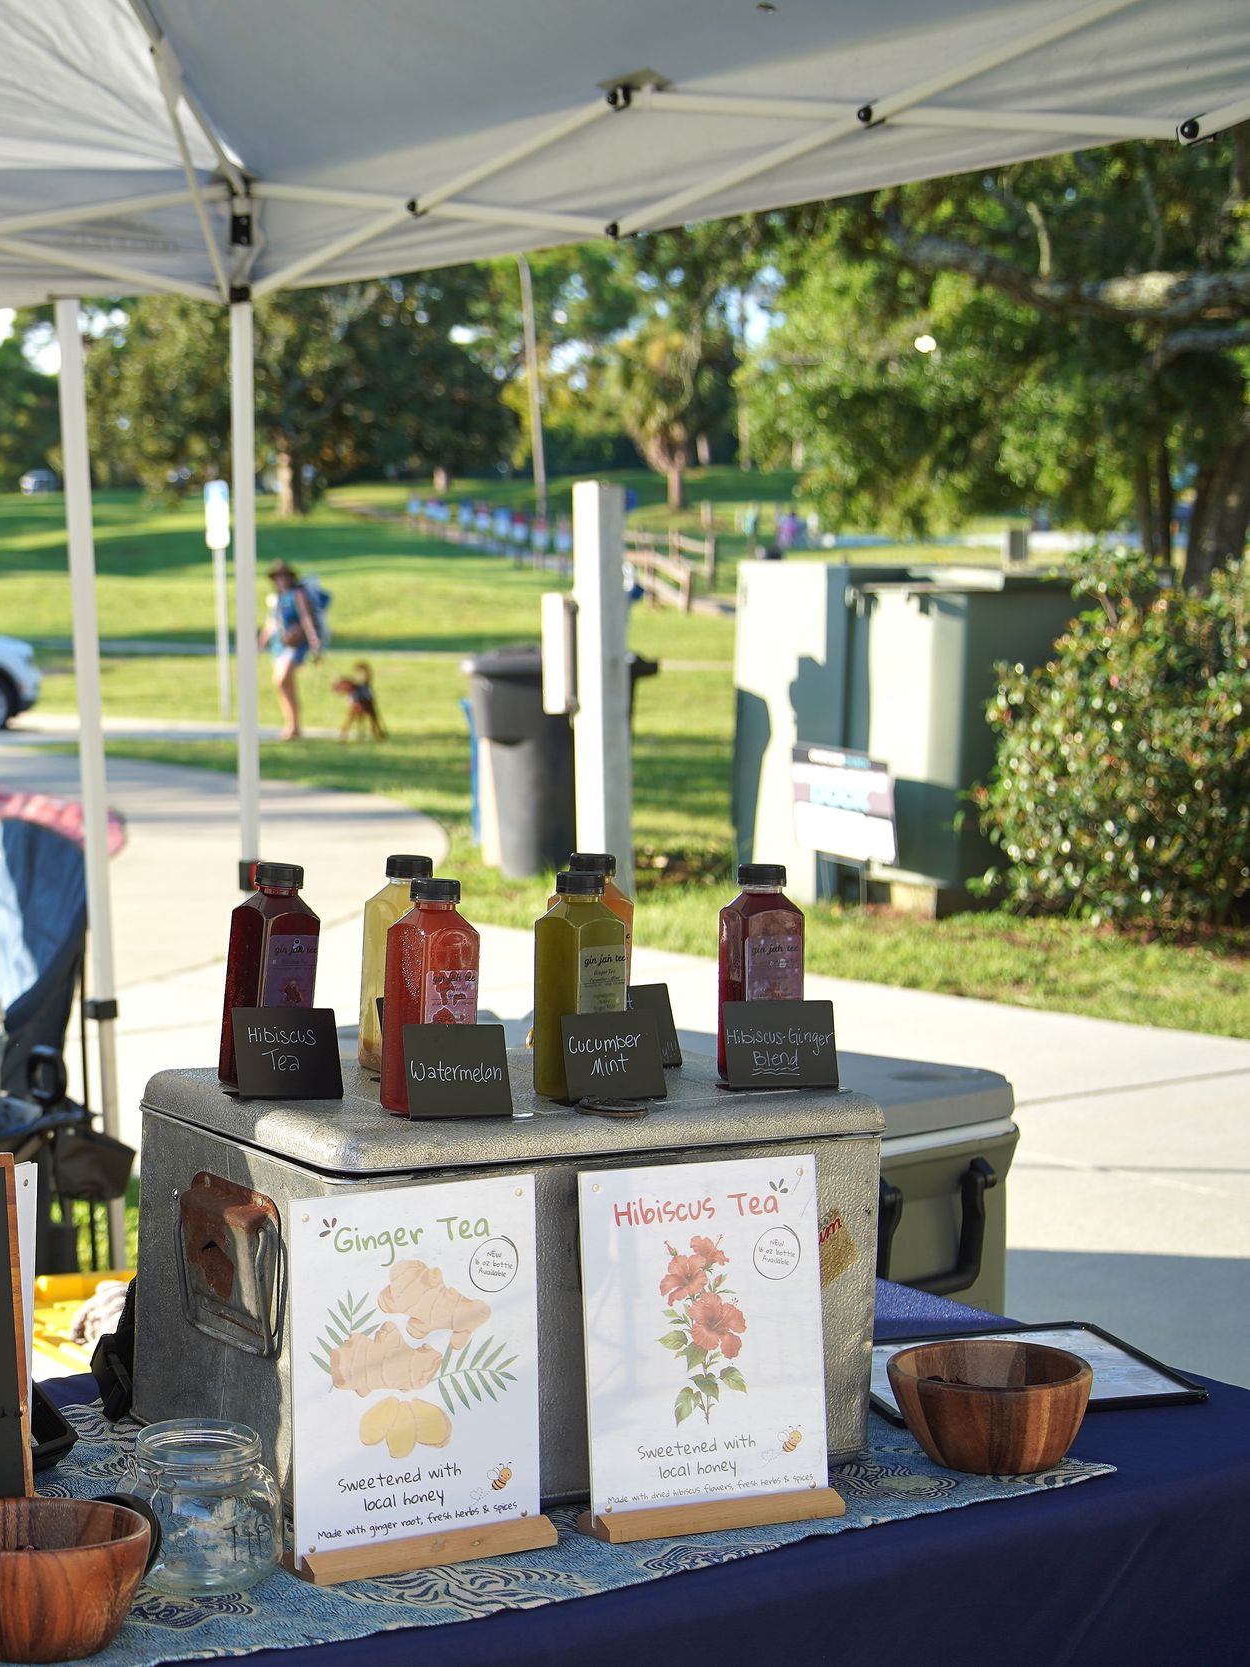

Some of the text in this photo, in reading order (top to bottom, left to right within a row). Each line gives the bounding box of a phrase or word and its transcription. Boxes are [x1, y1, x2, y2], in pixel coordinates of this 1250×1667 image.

[247, 1025, 317, 1046] Hibiscus
[568, 1033, 642, 1055] Cucumber
[261, 1048, 301, 1071] Tea
[590, 1053, 630, 1077] Mint
[753, 1050, 799, 1067] Blend
[409, 1060, 502, 1083] Watermelon
[614, 1192, 780, 1227] Hibiscus Tea
[334, 1216, 491, 1267] Ginger Tea
[770, 1239, 784, 1247] NEW
[487, 1250, 502, 1258] NEW
[493, 1260, 513, 1269] bottle
[762, 1255, 790, 1265] Available
[776, 1249, 795, 1258] bottle
[478, 1267, 507, 1277] Available
[637, 1434, 756, 1461] Sweetened with
[338, 1462, 462, 1493] Sweetened with
[659, 1459, 738, 1479] local honey
[607, 1495, 628, 1505] Made
[631, 1491, 649, 1502] with
[651, 1489, 670, 1500] dried
[673, 1486, 701, 1498] hibiscus
[737, 1479, 759, 1490] fresh
[760, 1476, 781, 1486] herbs
[784, 1475, 790, 1483] &
[792, 1472, 814, 1485] spices
[363, 1489, 445, 1512] local honey
[317, 1501, 518, 1540] Made with ginger root, fresh herbs & spices
